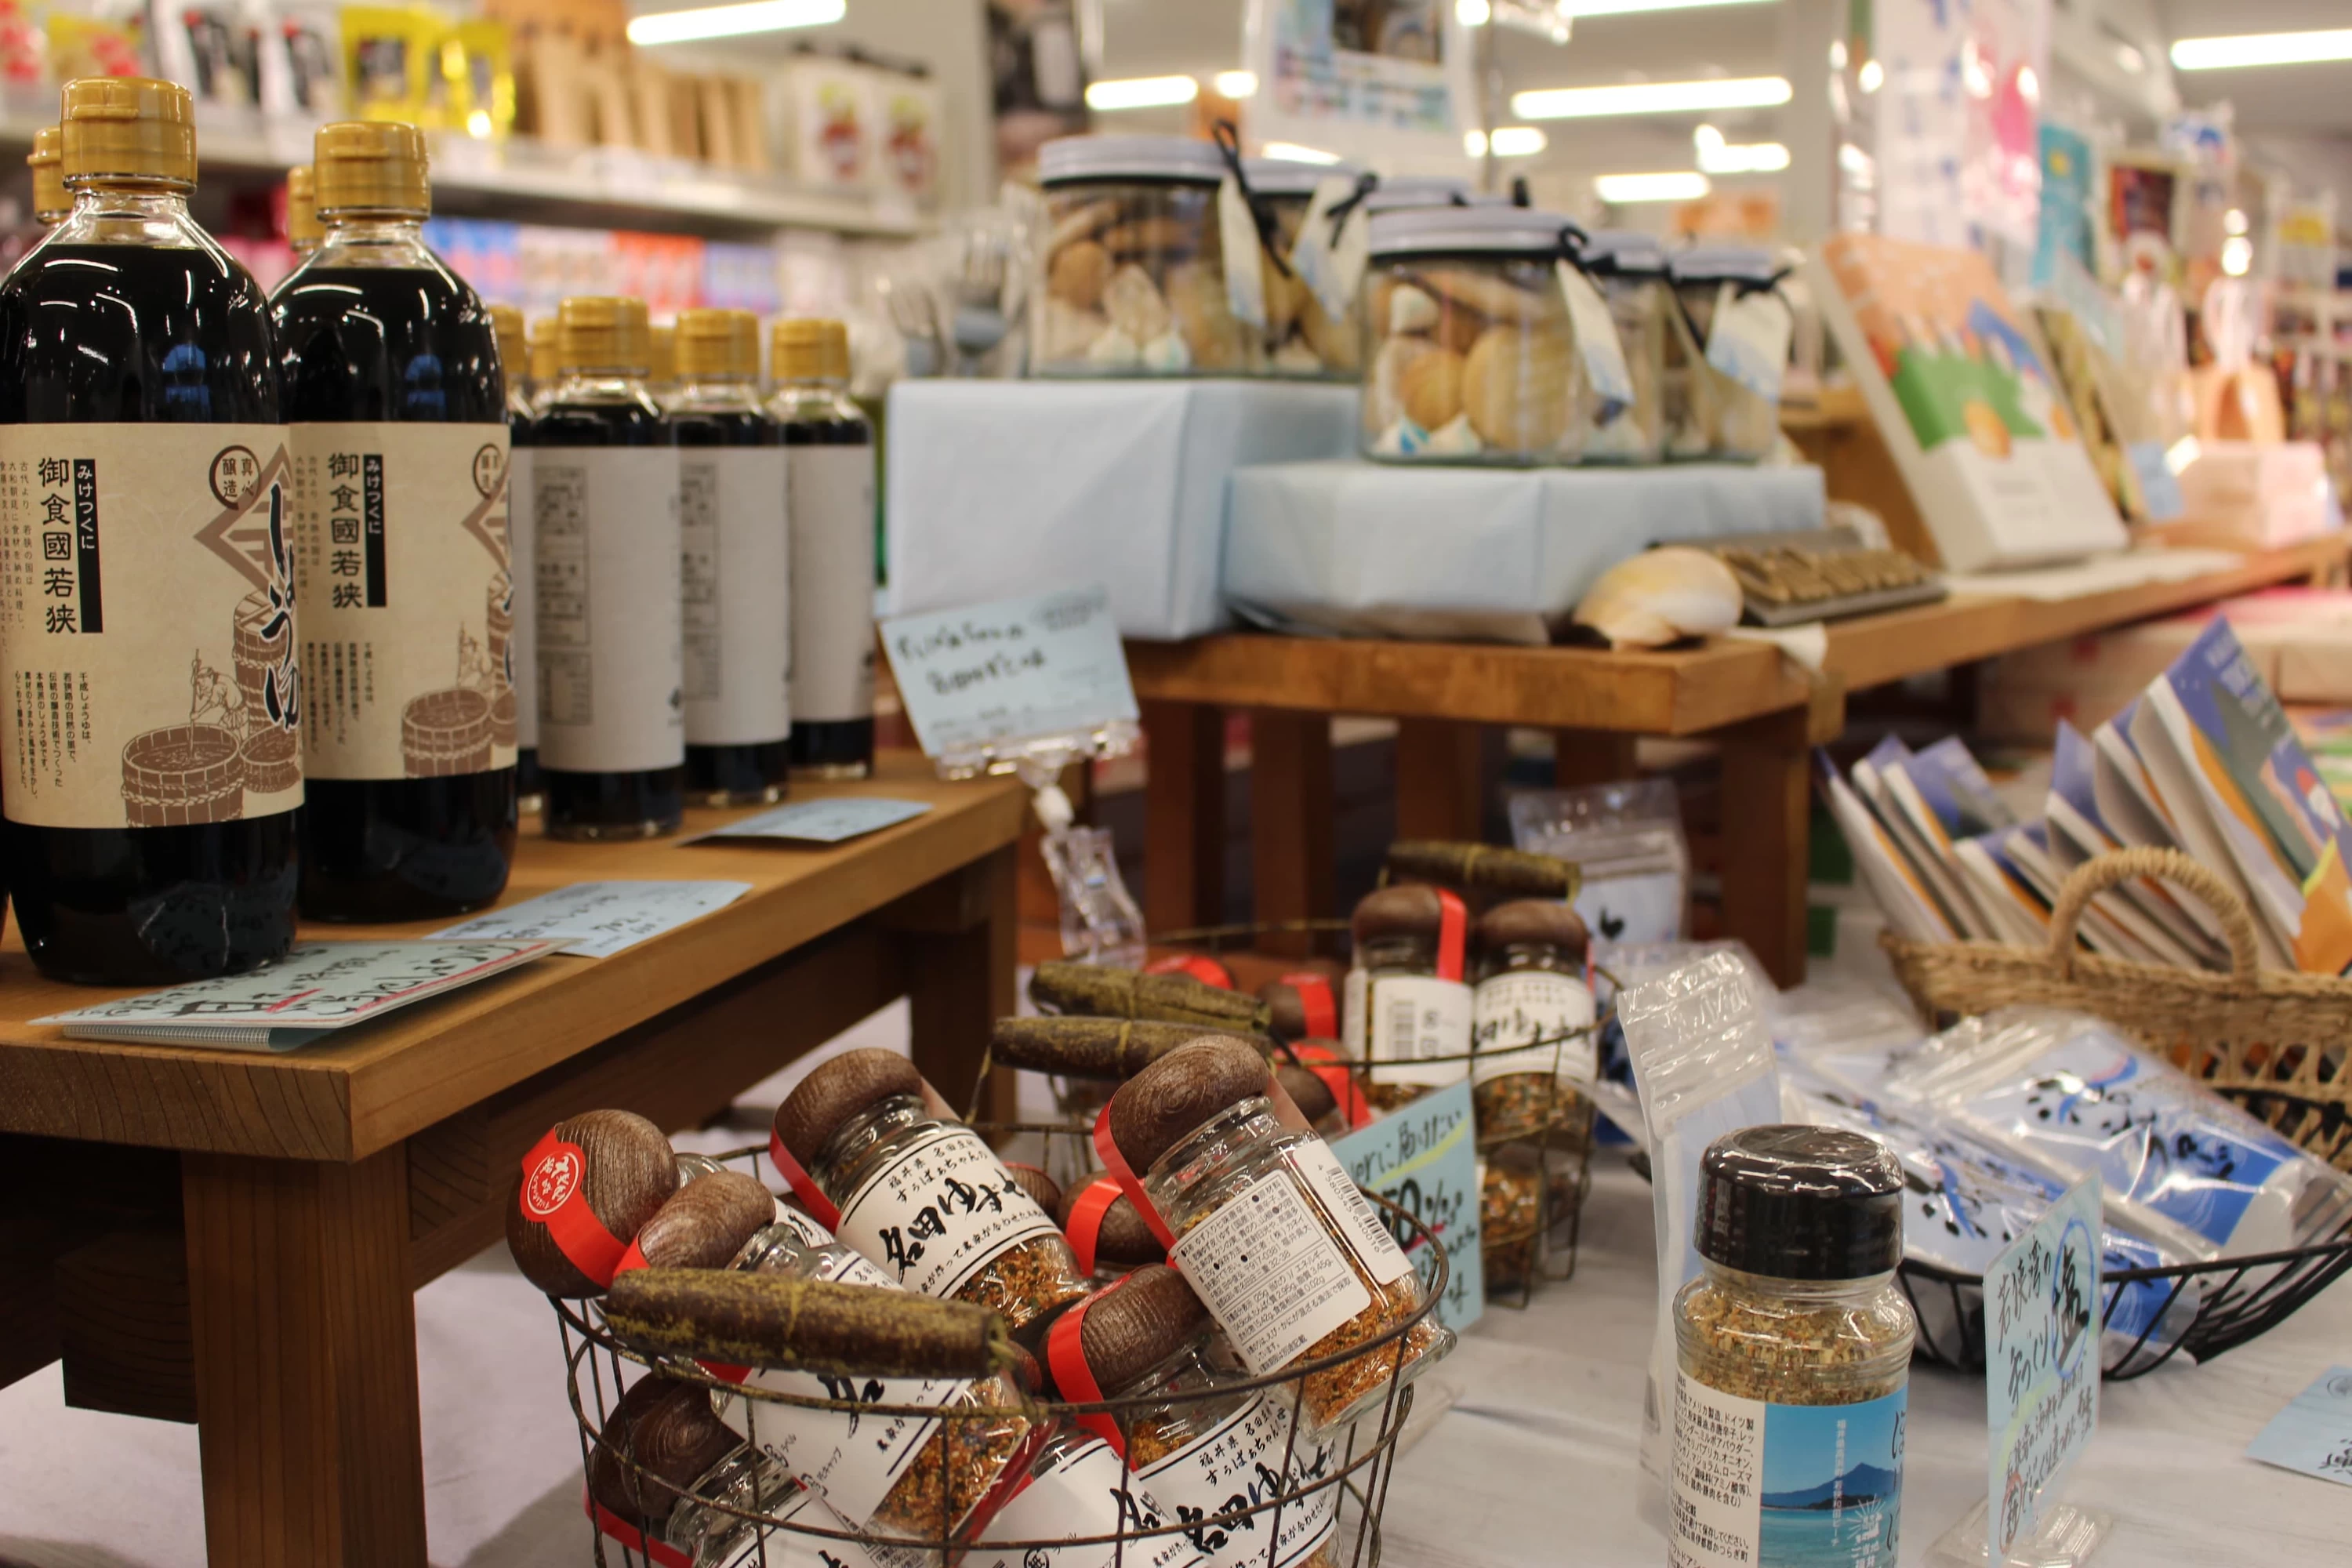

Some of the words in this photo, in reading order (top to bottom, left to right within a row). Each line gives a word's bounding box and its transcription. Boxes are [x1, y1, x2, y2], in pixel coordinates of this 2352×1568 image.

[76, 463, 96, 550] みけつくに
[328, 453, 364, 608] 御食國若狭
[366, 459, 382, 535] みけつくに
[38, 457, 78, 634] 御食國若狭
[1199, 1435, 1239, 1470] 福井県
